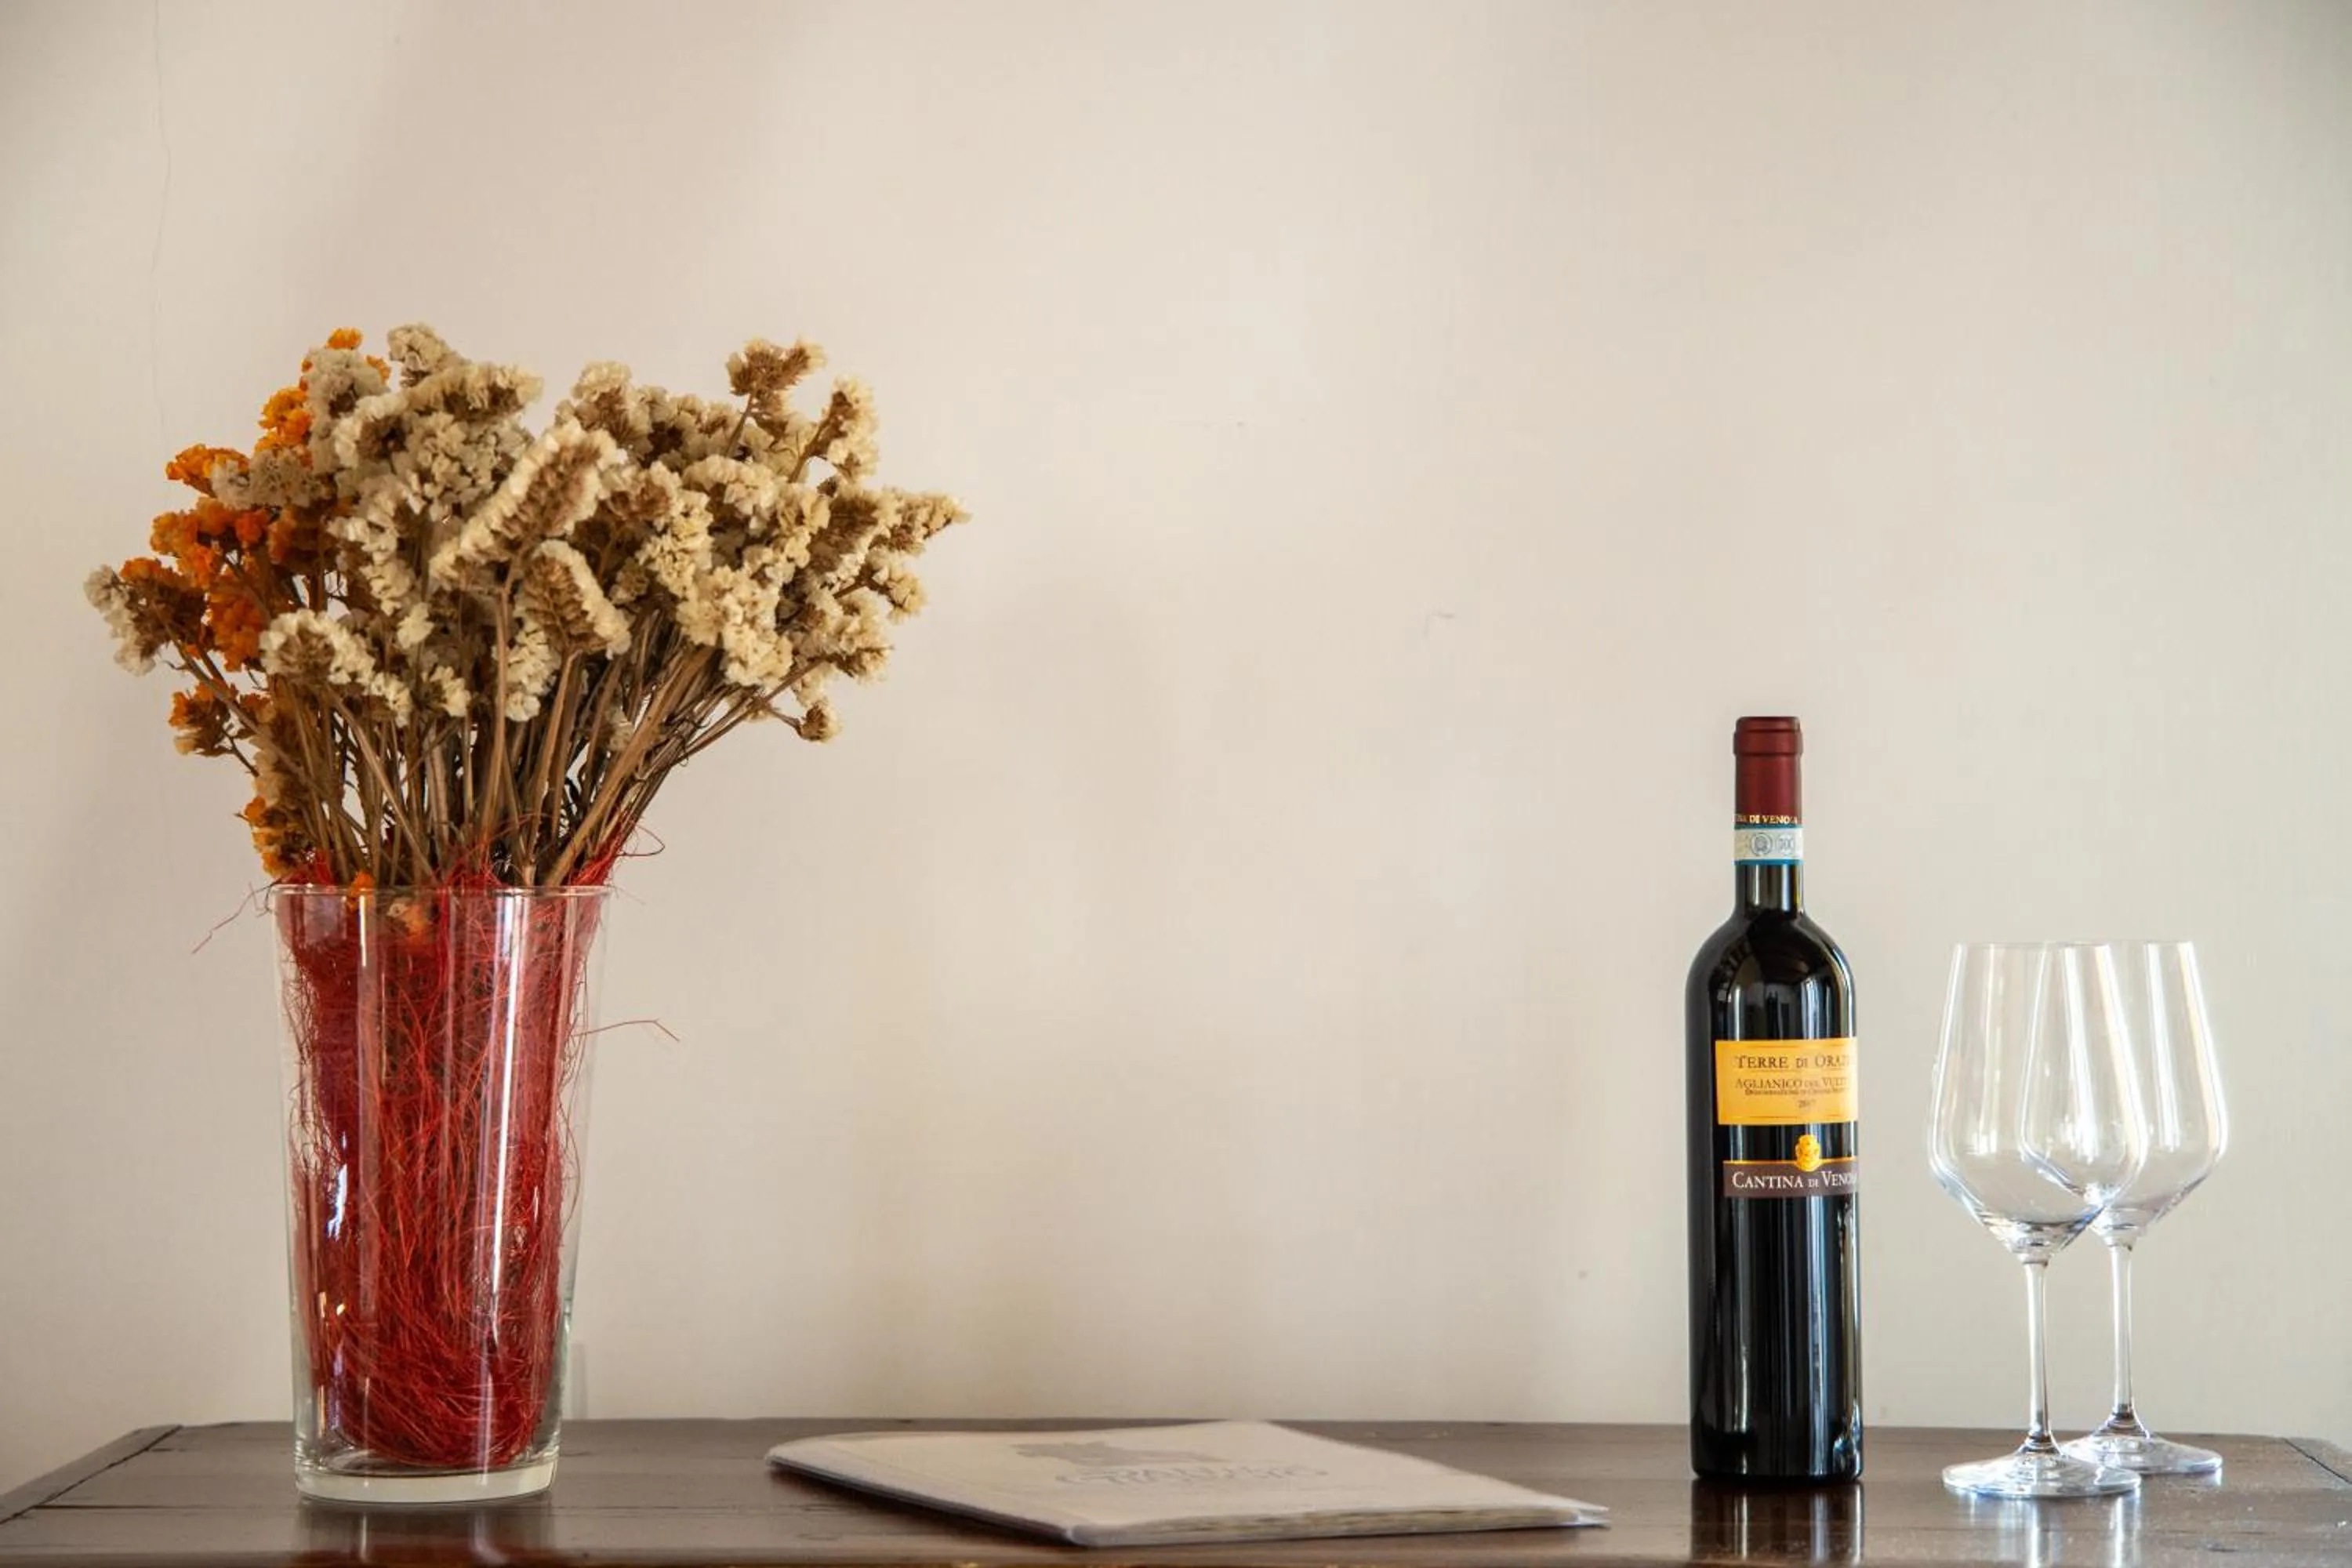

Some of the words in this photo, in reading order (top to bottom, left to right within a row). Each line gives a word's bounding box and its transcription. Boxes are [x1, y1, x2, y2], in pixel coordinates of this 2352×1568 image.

[1736, 1054, 1788, 1069] TERRE
[1796, 1057, 1808, 1069] DI
[1735, 1078, 1802, 1089] AGLIANICO
[1732, 1171, 1803, 1189] CANTINA
[1808, 1178, 1820, 1188] DI
